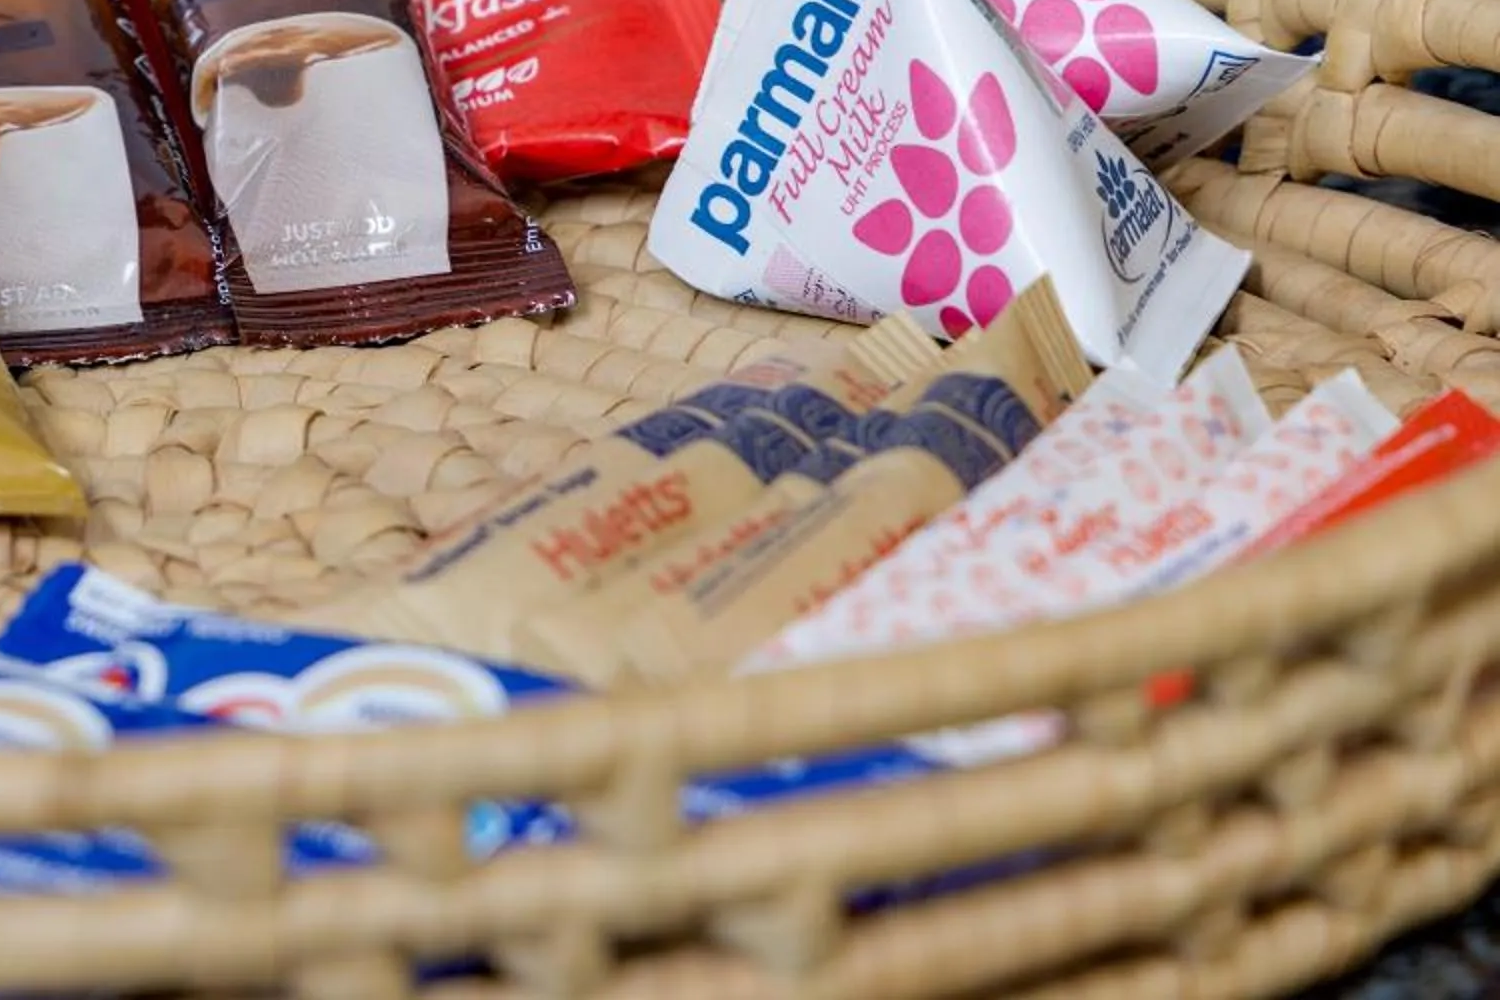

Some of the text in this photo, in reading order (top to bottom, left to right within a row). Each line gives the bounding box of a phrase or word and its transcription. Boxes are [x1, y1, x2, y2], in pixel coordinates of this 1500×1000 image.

[769, 0, 895, 225] Full Cream
[828, 89, 887, 188] Milk
[840, 100, 908, 216] UHT PROCESS
